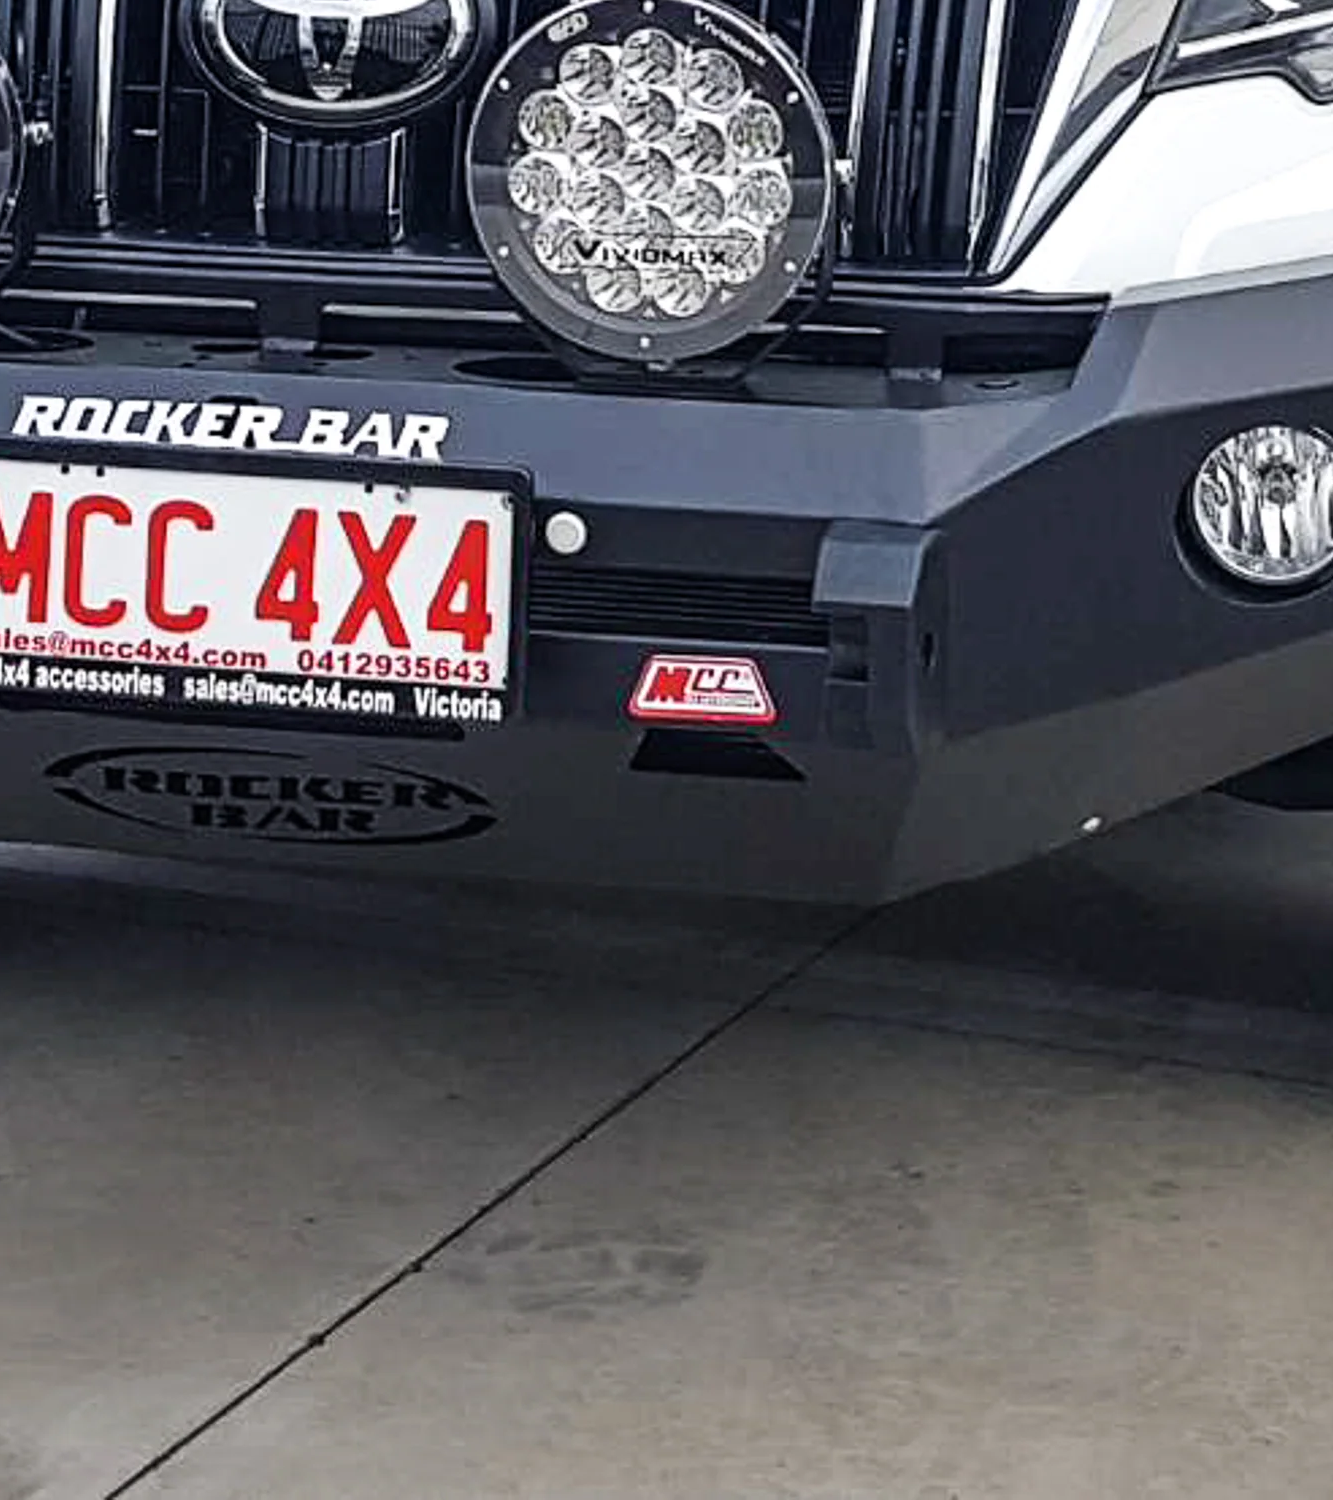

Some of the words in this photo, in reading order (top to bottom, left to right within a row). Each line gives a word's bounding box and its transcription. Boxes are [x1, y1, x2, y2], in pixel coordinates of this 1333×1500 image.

[12, 395, 283, 449] ROCKER
[301, 408, 449, 461] BAR
[255, 507, 493, 653] 4X4
[296, 649, 491, 683] 0412935643
[35, 665, 166, 697] accessories
[183, 672, 395, 714] sales@mcc4x4.com
[414, 687, 502, 722] Victoria
[103, 765, 453, 810] ROCKER
[191, 803, 379, 834] BAR
